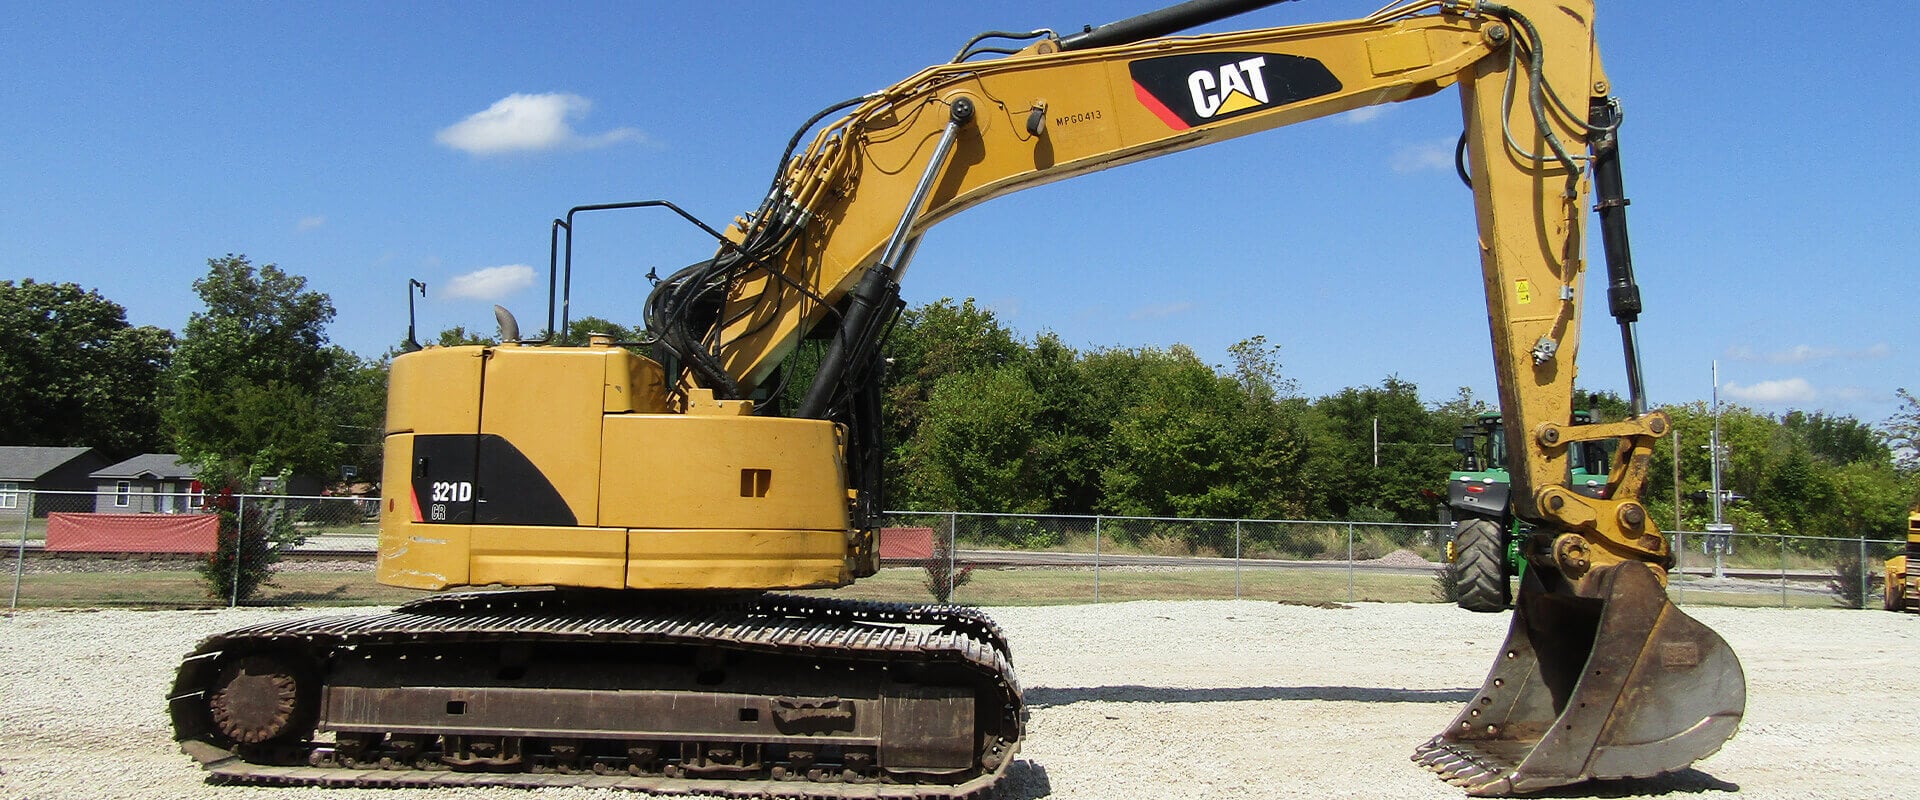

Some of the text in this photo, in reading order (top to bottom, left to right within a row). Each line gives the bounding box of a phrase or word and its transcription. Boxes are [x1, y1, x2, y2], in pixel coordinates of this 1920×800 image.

[1187, 56, 1269, 118] CAT
[1056, 110, 1102, 126] MPG0413
[431, 504, 446, 520] CR
